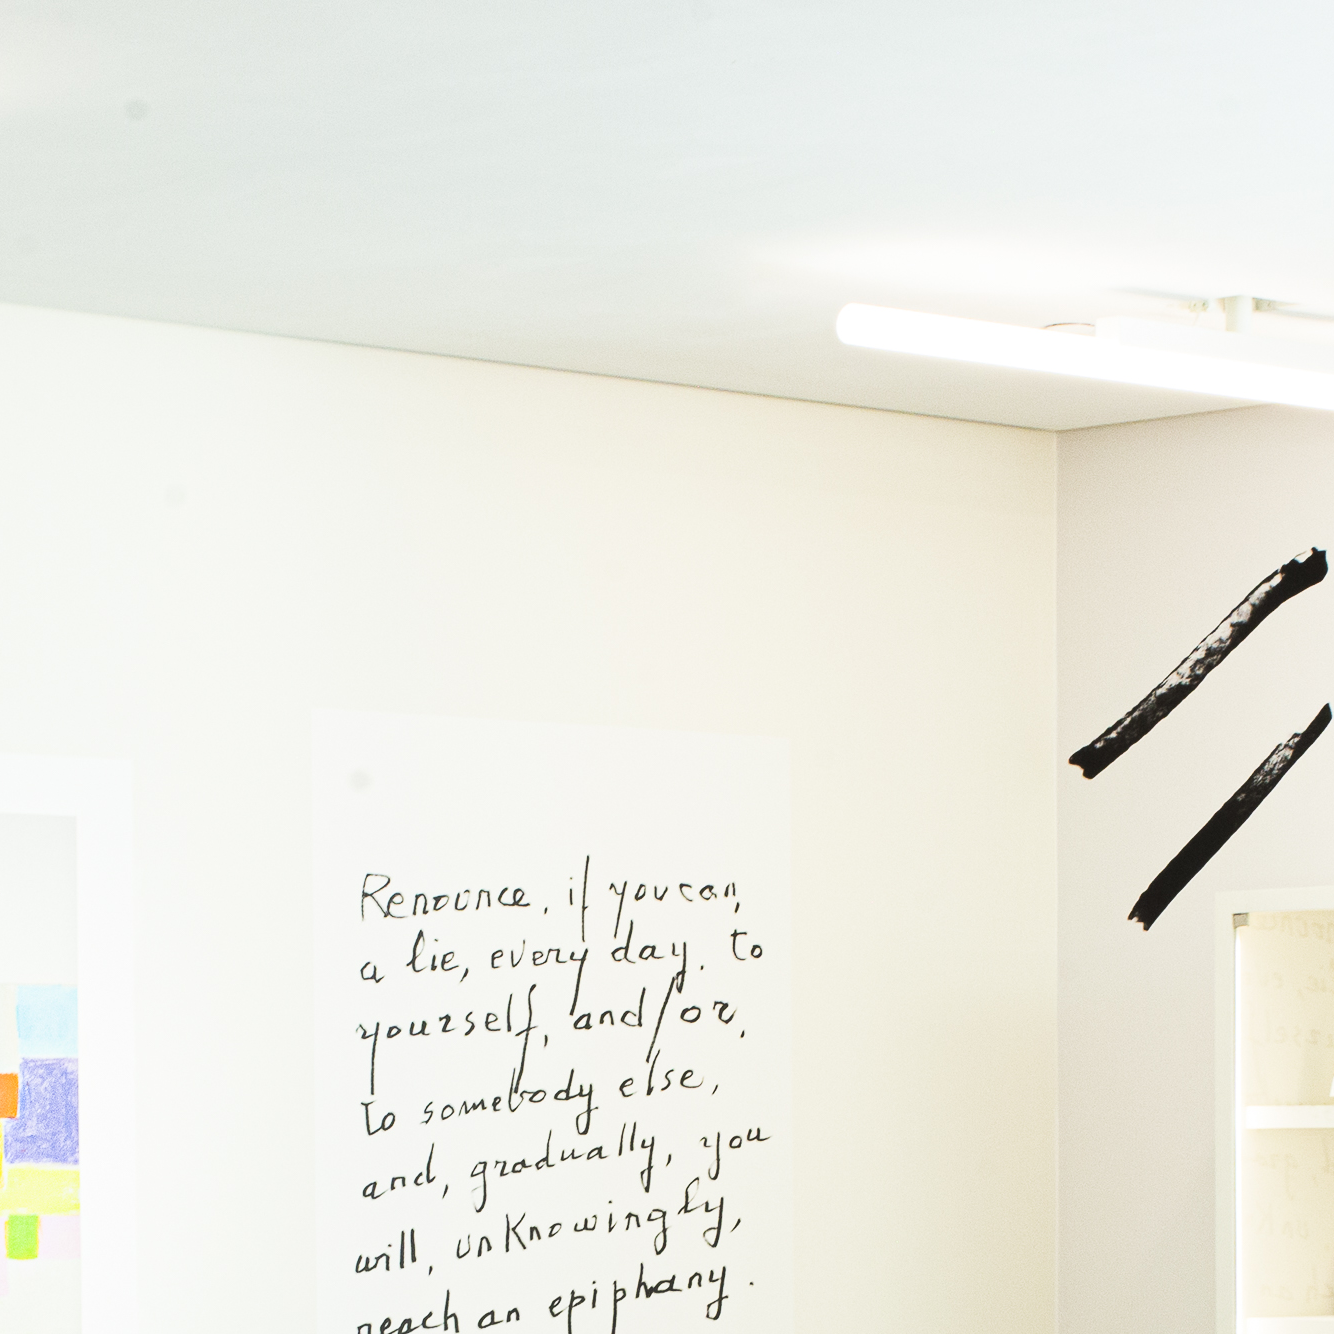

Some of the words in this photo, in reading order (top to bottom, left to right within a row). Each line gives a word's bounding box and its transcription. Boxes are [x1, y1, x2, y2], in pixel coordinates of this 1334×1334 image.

[361, 873, 548, 920] Renounce,
[569, 855, 589, 941] if
[360, 959, 385, 983] a
[408, 930, 470, 983] lie,
[490, 941, 589, 1016] every
[730, 929, 764, 962] to
[356, 984, 549, 1096] yourself,
[361, 1100, 396, 1137] to
[423, 1067, 599, 1135] somebody
[619, 1048, 720, 1097] else,
[363, 1142, 450, 1200] and,
[470, 1122, 673, 1214] gradually,
[699, 1125, 771, 1181] you
[355, 1229, 434, 1277] will,
[477, 1304, 521, 1331] an
